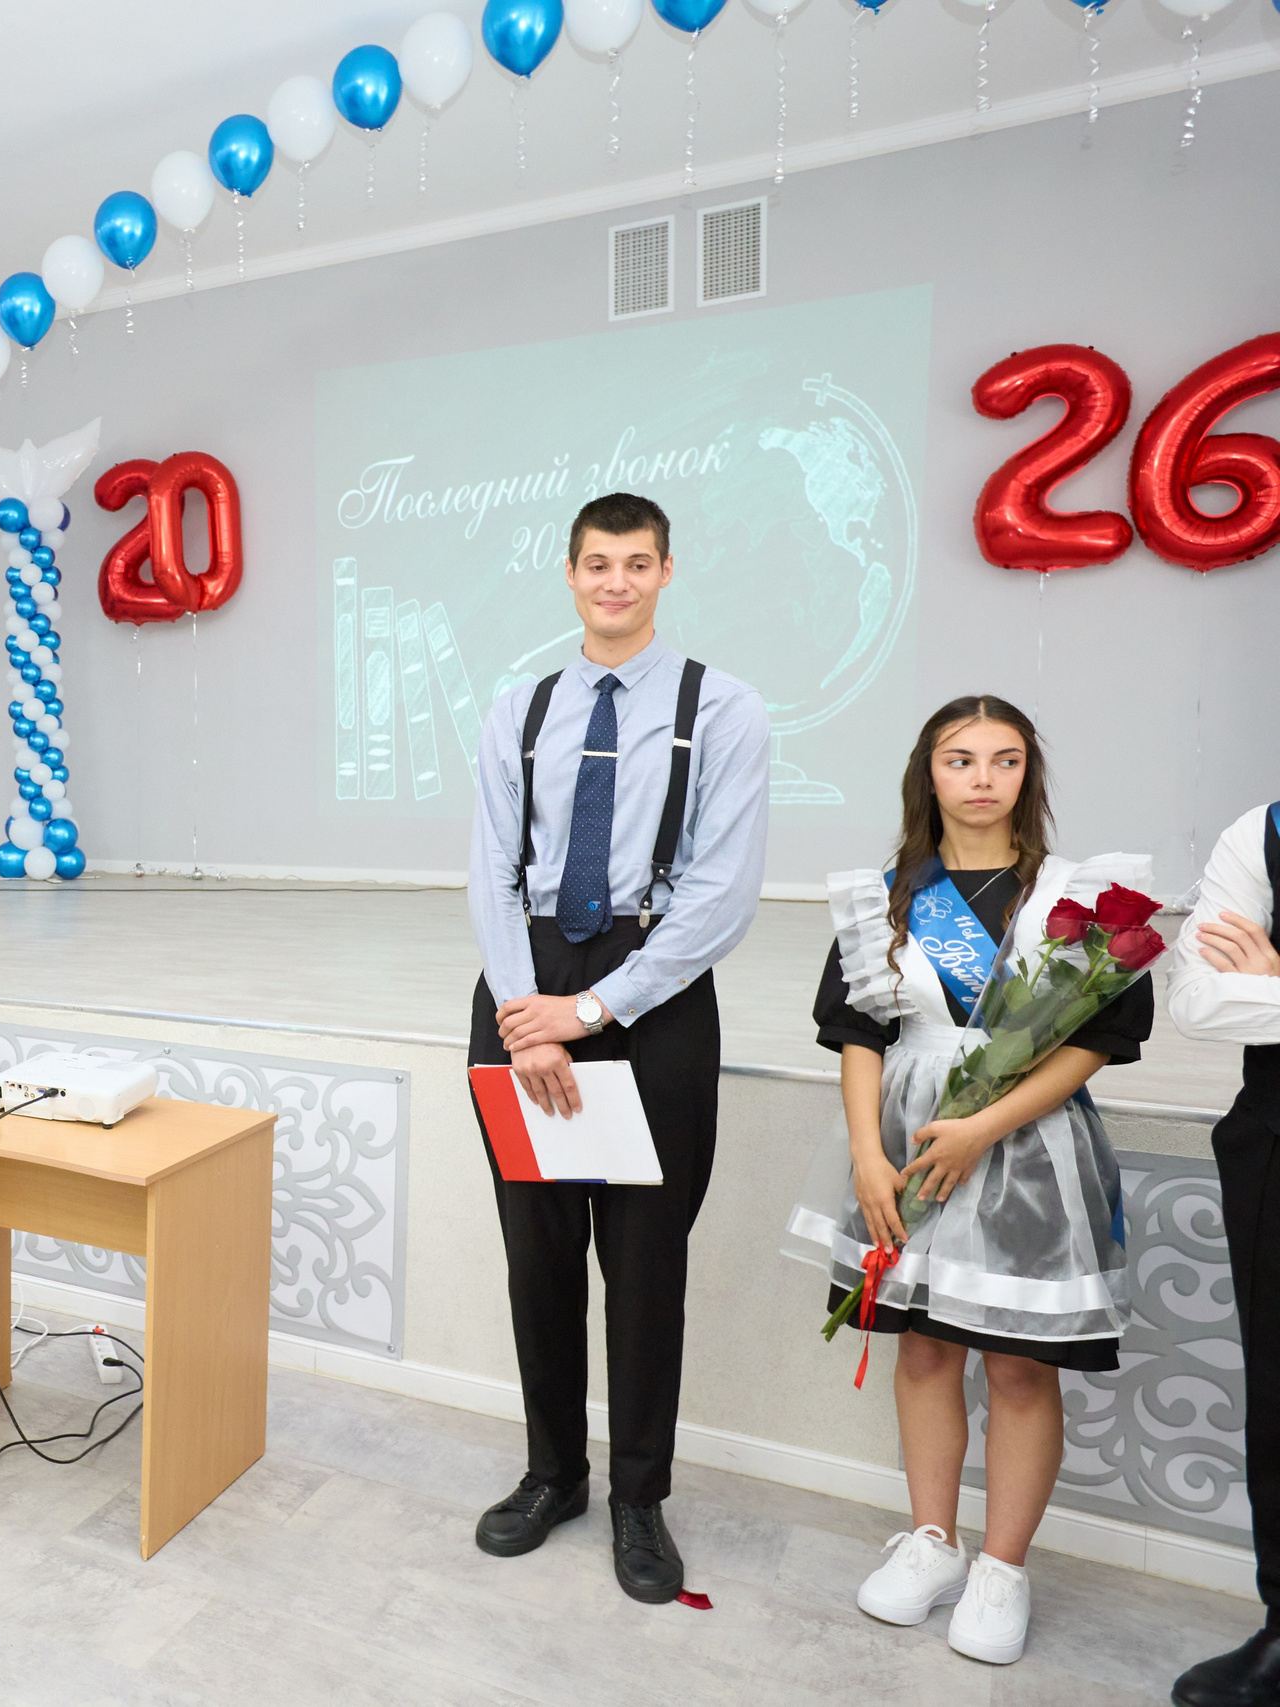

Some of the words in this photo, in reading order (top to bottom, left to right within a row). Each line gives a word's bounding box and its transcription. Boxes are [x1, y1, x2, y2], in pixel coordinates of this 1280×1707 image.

[338, 453, 571, 540] Последний
[581, 426, 731, 503] звонок
[971, 332, 1280, 573] 26
[94, 451, 243, 626] 20
[505, 519, 572, 575] 202
